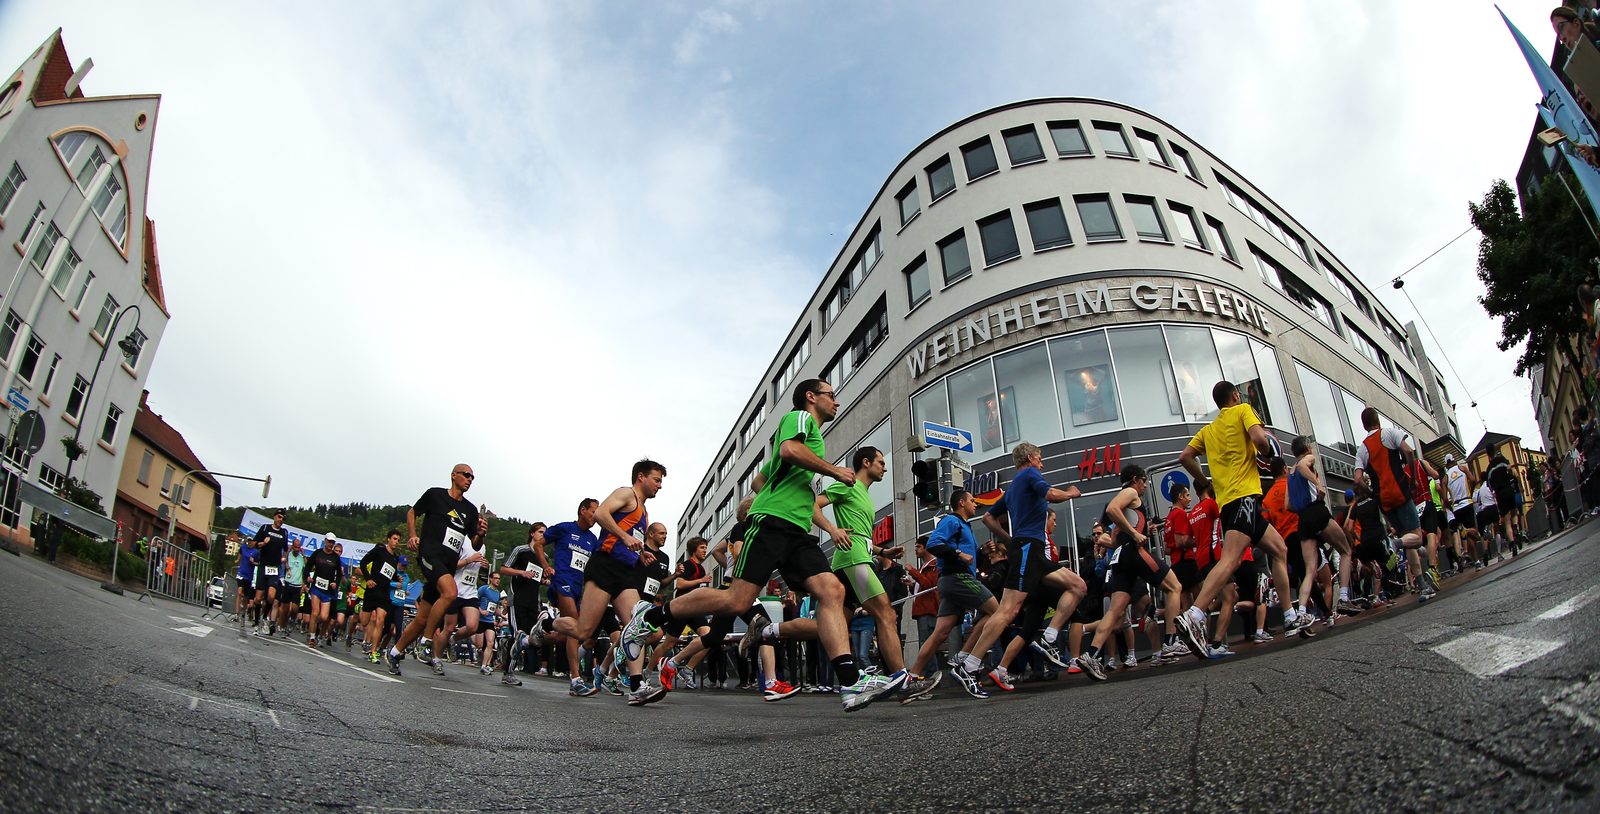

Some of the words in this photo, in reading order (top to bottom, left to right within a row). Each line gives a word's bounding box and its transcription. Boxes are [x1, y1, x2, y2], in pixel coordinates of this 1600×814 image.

[906, 282, 1115, 379] WEINHEIM
[1130, 280, 1273, 334] GALERIE
[927, 430, 960, 443] Einbahnstraße
[1323, 456, 1356, 480] DEPO
[963, 471, 998, 496] dm
